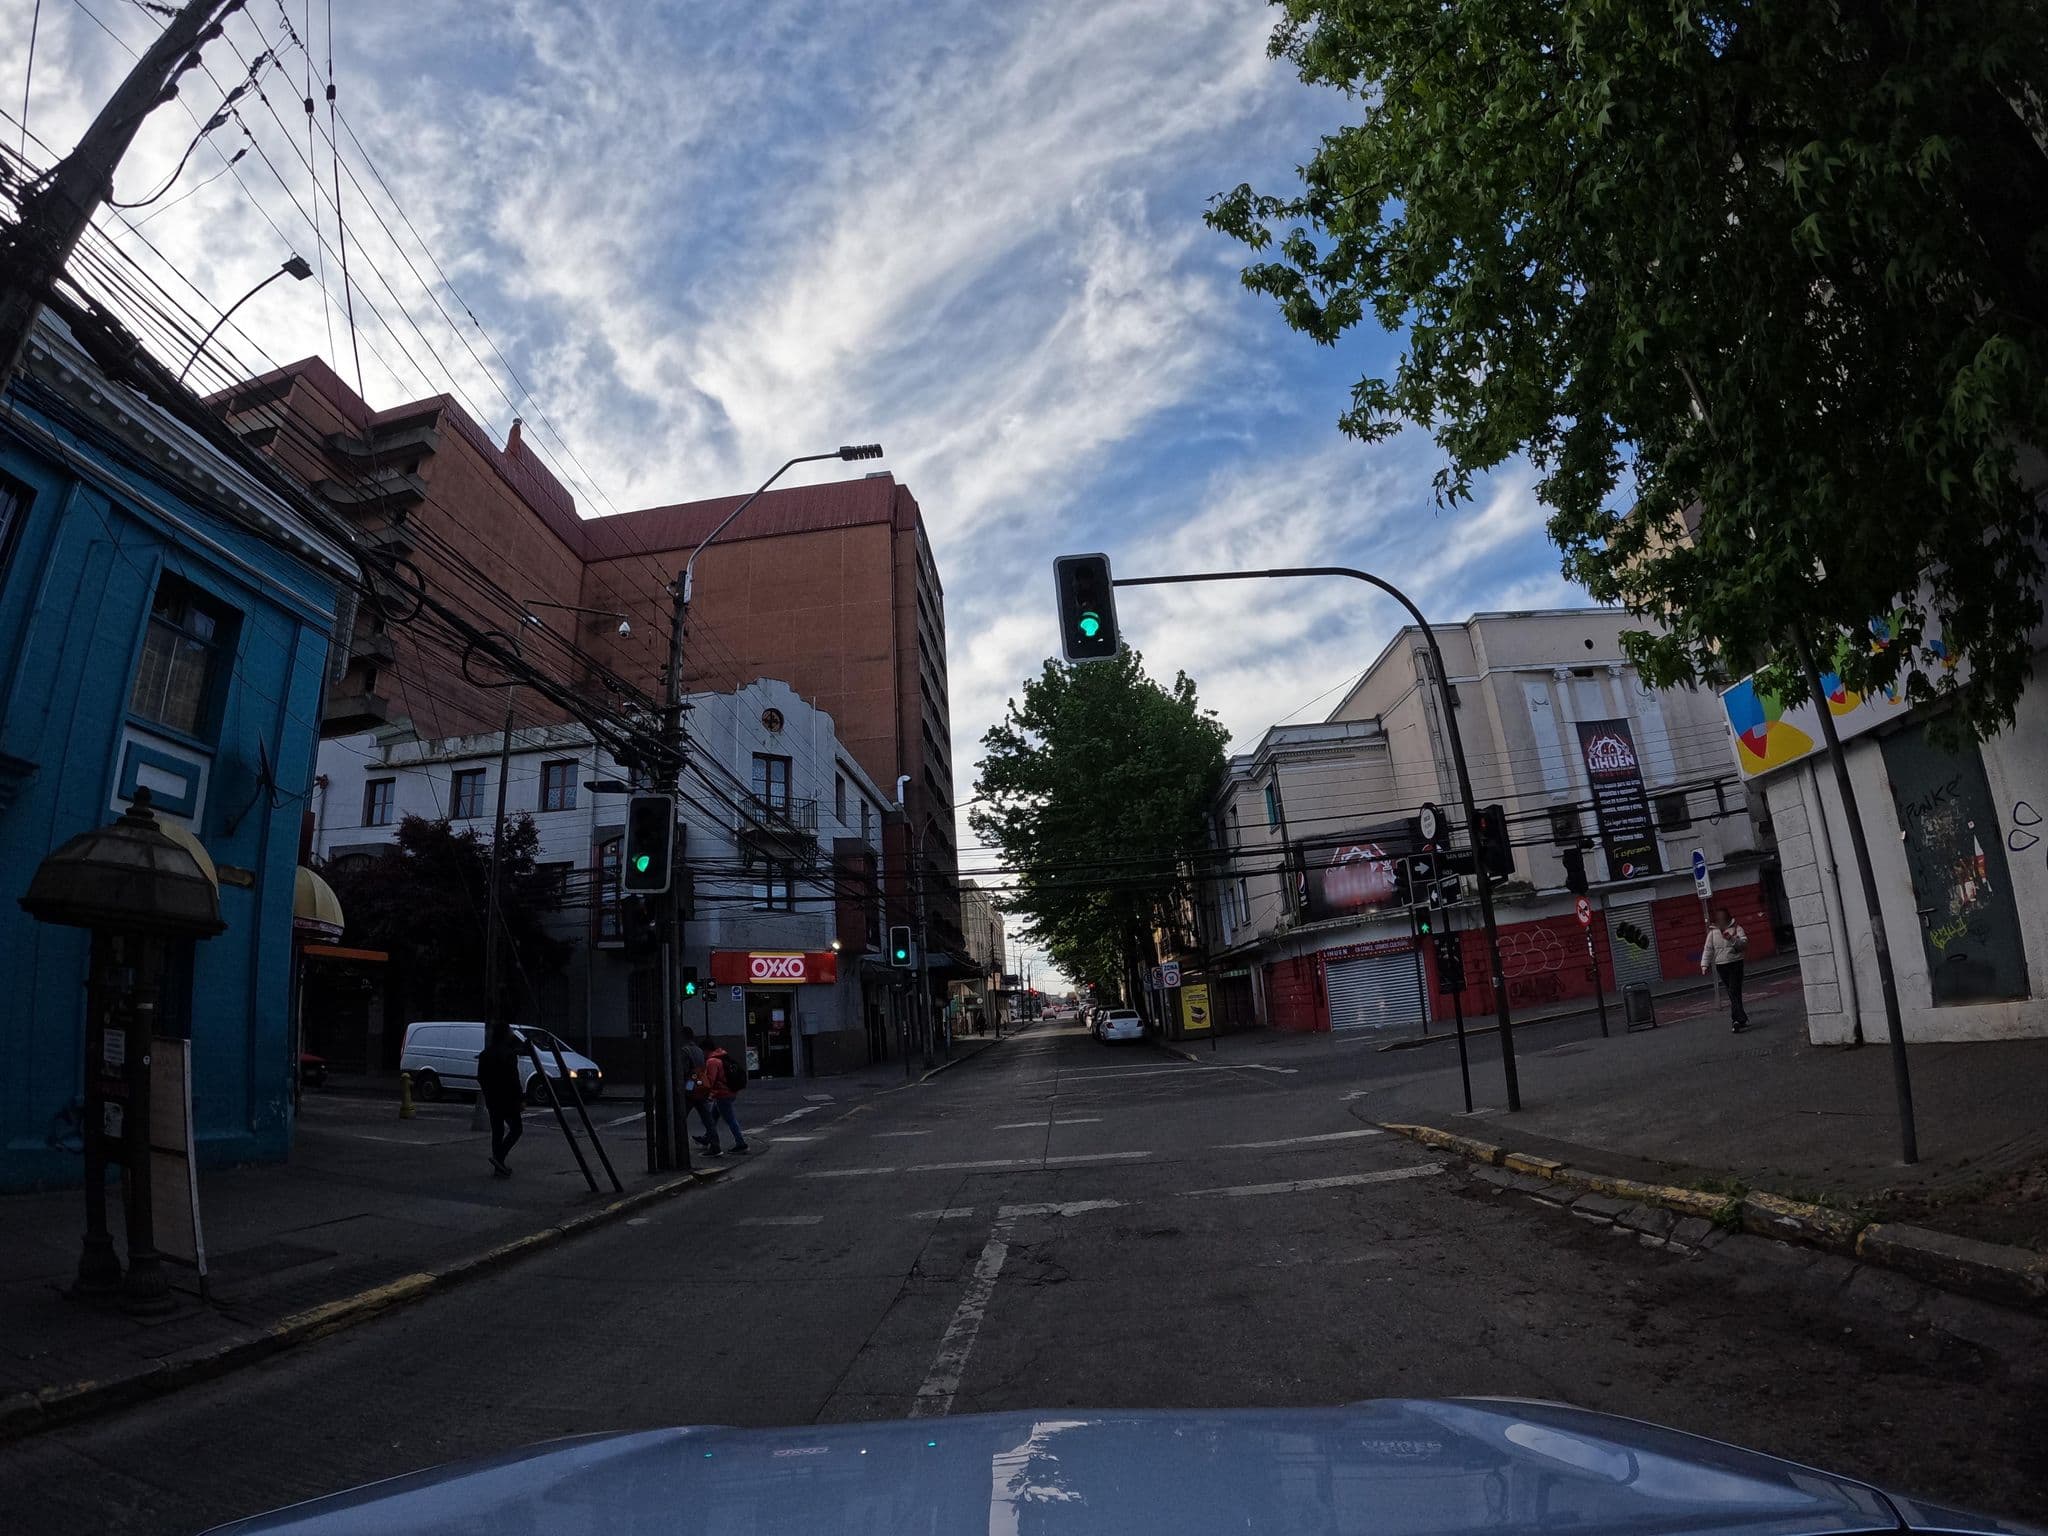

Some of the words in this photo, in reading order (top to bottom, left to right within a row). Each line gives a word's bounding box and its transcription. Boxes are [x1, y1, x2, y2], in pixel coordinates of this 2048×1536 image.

[1588, 755, 1635, 770] LIHUEN
[1323, 948, 1349, 959] LIHUEN
[751, 958, 804, 977] OXXO
